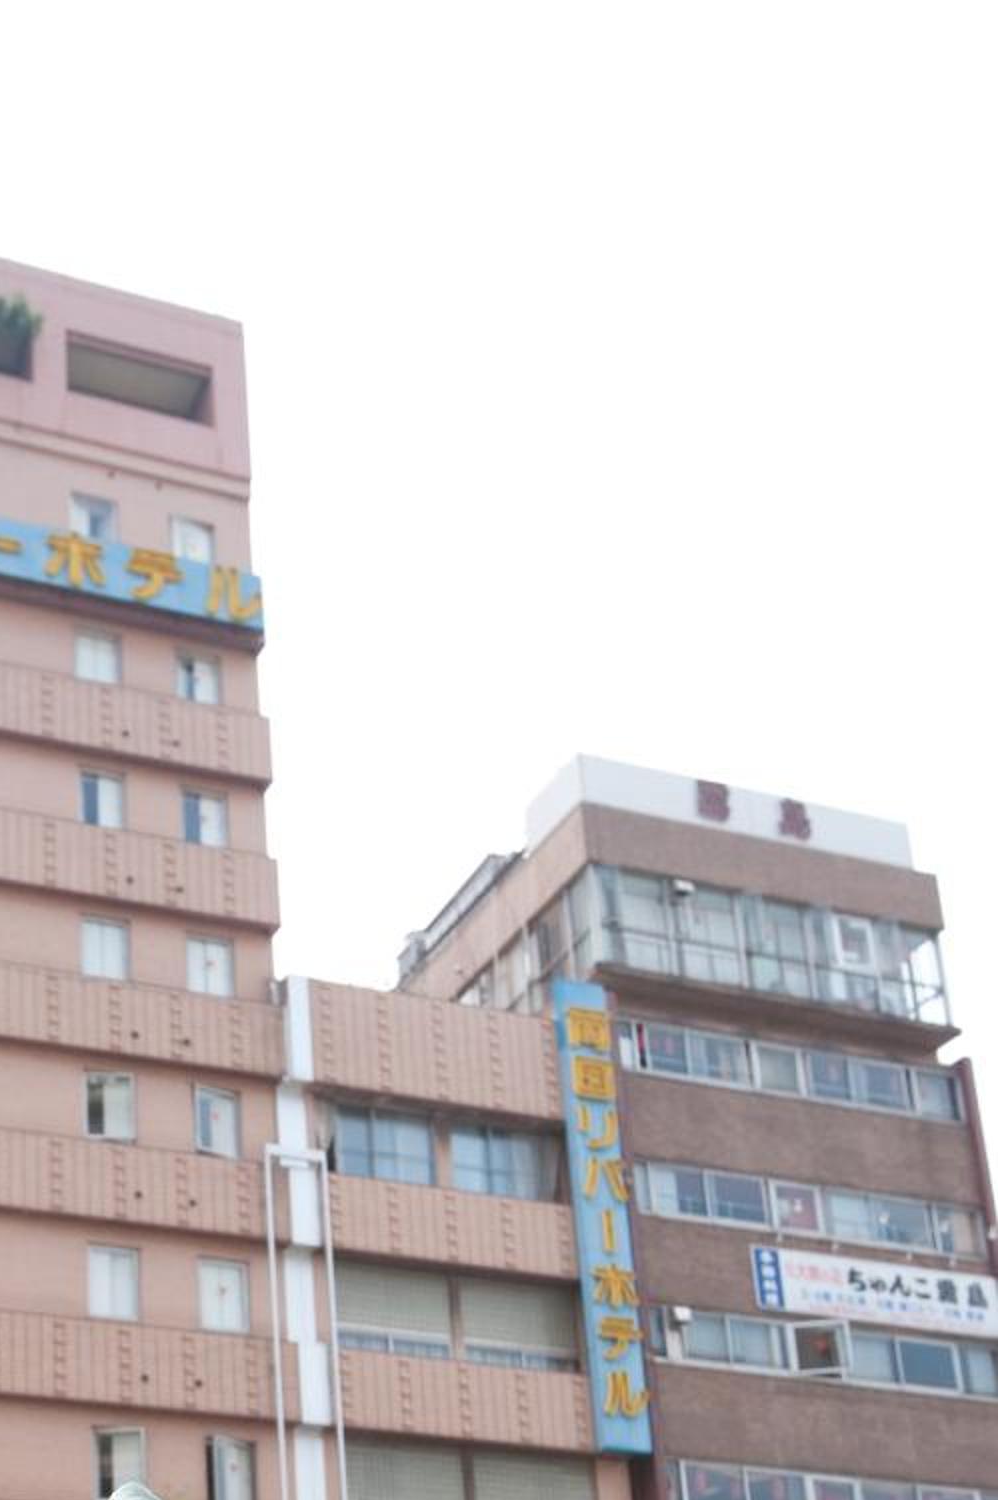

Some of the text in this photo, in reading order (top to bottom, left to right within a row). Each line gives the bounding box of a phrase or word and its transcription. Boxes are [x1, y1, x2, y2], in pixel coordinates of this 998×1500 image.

[565, 1007, 649, 1418] 両国リバーホテル
